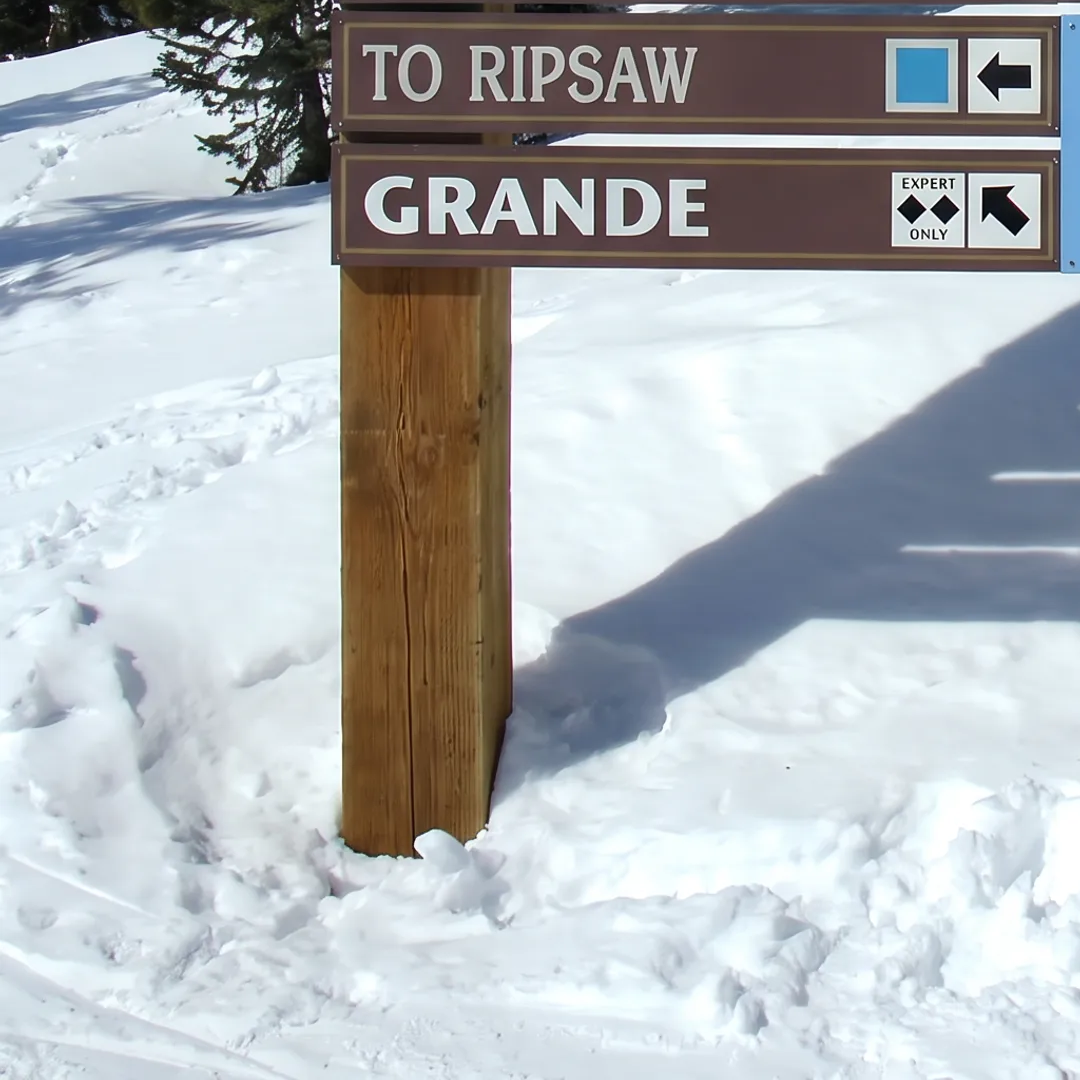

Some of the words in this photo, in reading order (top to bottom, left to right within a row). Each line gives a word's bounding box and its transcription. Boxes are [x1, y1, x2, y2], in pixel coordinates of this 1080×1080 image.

[363, 44, 442, 102] TO
[469, 45, 697, 103] RIPSAW
[903, 178, 955, 189] EXPERT
[365, 176, 708, 236] GRANDE
[910, 229, 947, 240] ONLY
